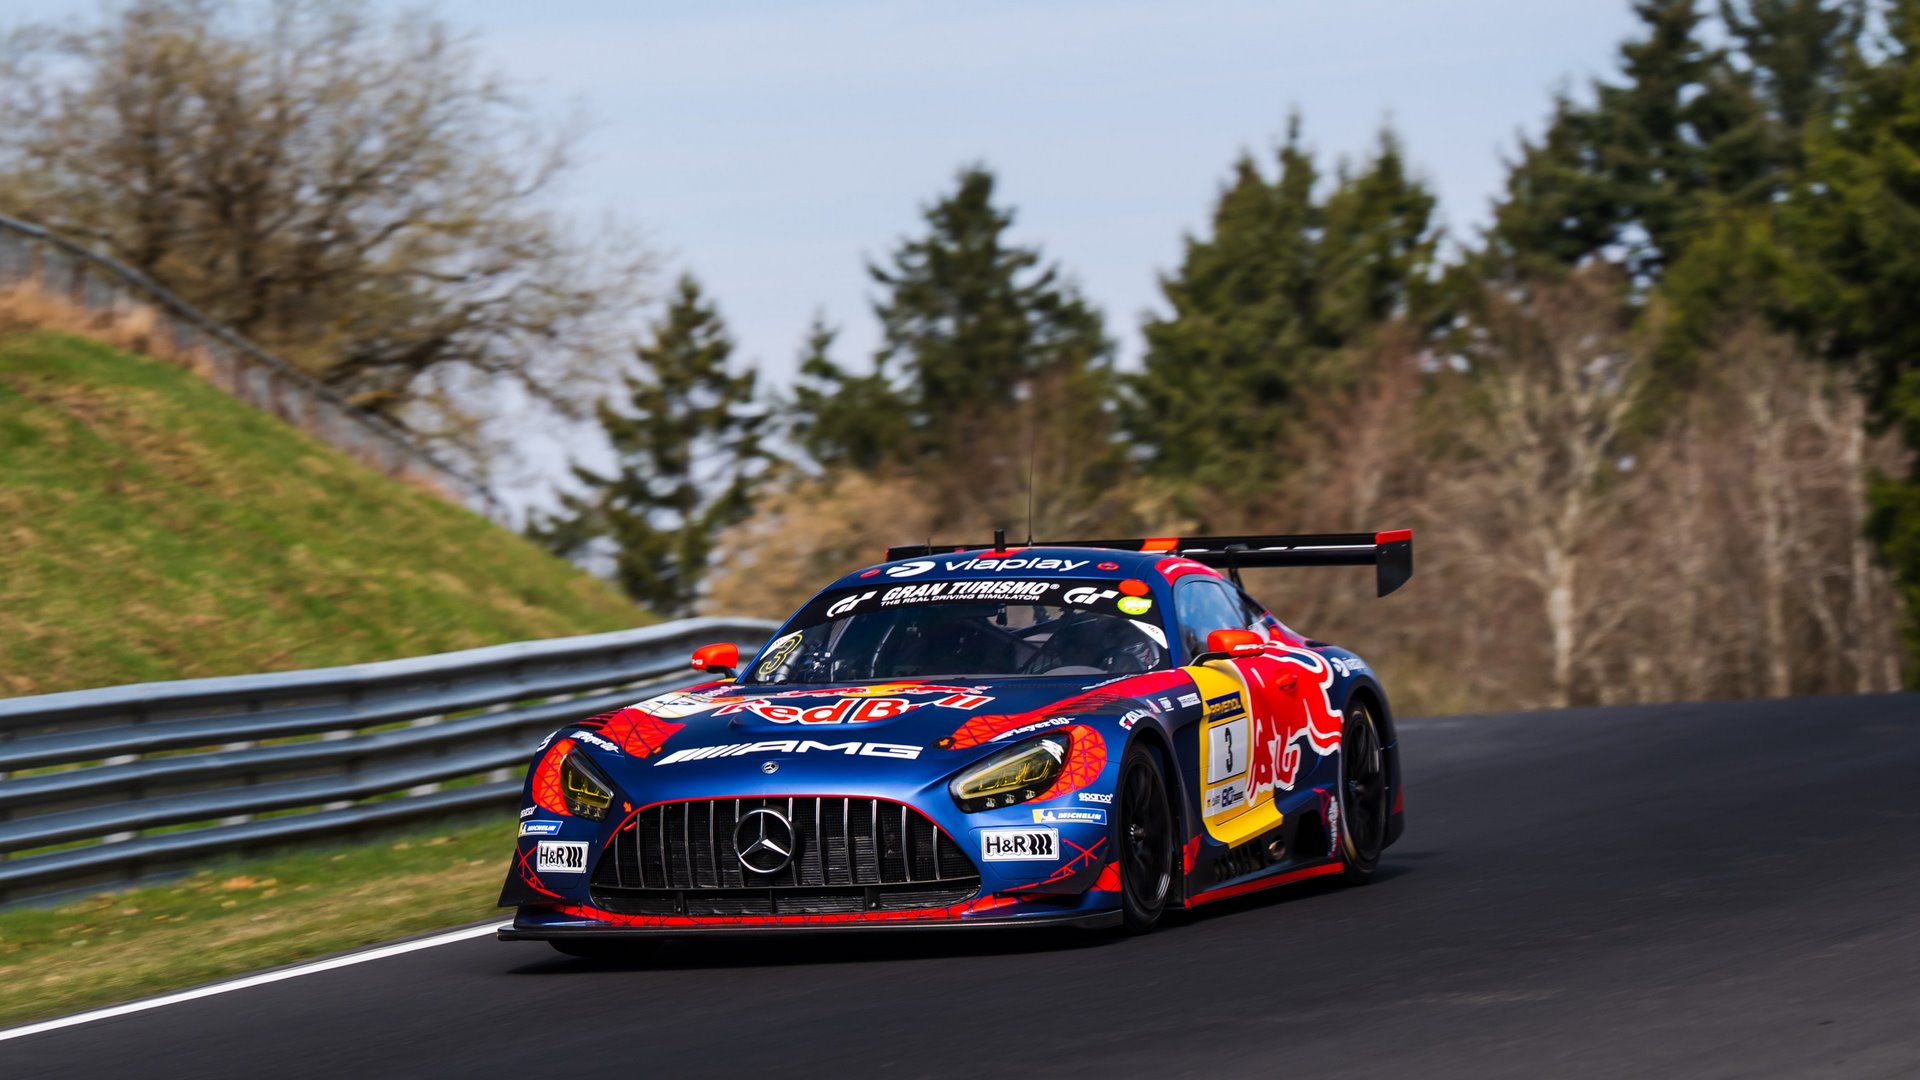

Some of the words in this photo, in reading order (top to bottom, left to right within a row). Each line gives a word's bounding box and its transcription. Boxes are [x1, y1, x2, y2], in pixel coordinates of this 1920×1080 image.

[945, 557, 1090, 572] viaplay
[880, 599, 901, 607] THE
[902, 596, 930, 605] REAL
[930, 594, 976, 602] DRIVING
[976, 593, 1041, 601] SIMULATOR
[881, 582, 949, 602] GRAN
[758, 633, 804, 675] 3
[711, 698, 861, 725] Red
[747, 740, 924, 760] AMG
[1225, 727, 1234, 773] 3
[1057, 812, 1102, 820] MICHELIN
[527, 824, 557, 832] MICHELIN
[986, 835, 1027, 854] H&R
[540, 847, 565, 865] H&R
